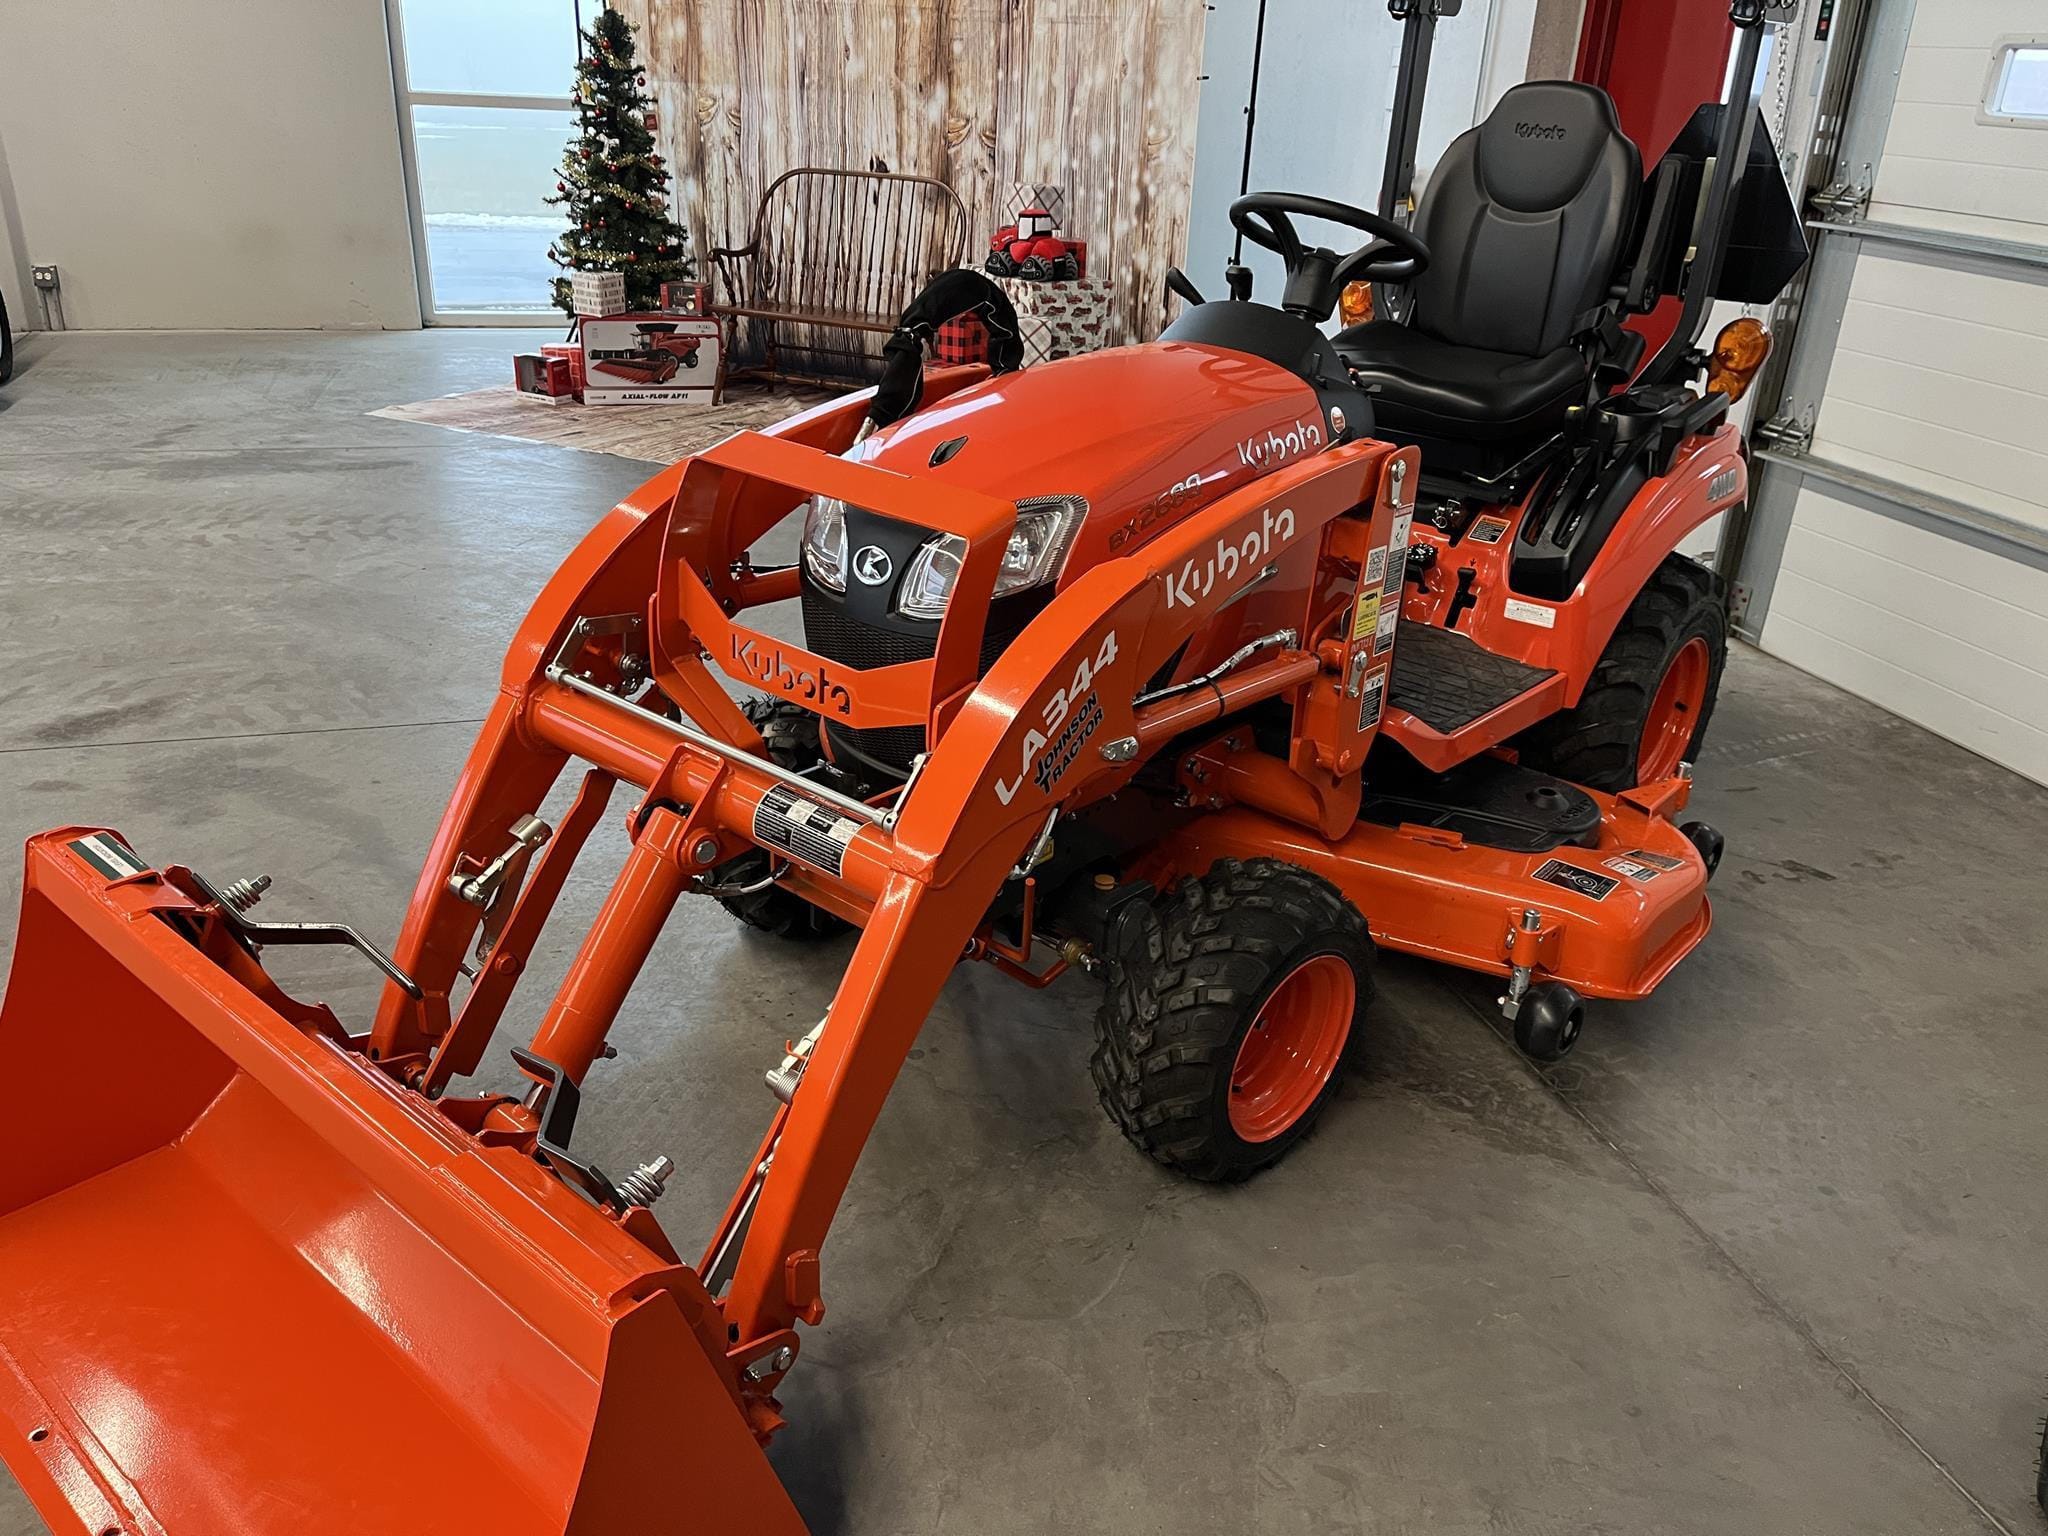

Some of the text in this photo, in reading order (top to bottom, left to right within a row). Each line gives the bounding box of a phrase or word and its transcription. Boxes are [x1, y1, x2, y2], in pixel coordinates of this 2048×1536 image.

[1514, 122, 1566, 140] Kubota
[1237, 420, 1321, 469] Kubota
[1166, 508, 1295, 609] Kubota
[732, 633, 851, 715] Kubota
[994, 630, 1118, 806] LA344
[1033, 691, 1098, 785] JOHNSON
[1039, 707, 1104, 795] TRACTOR
